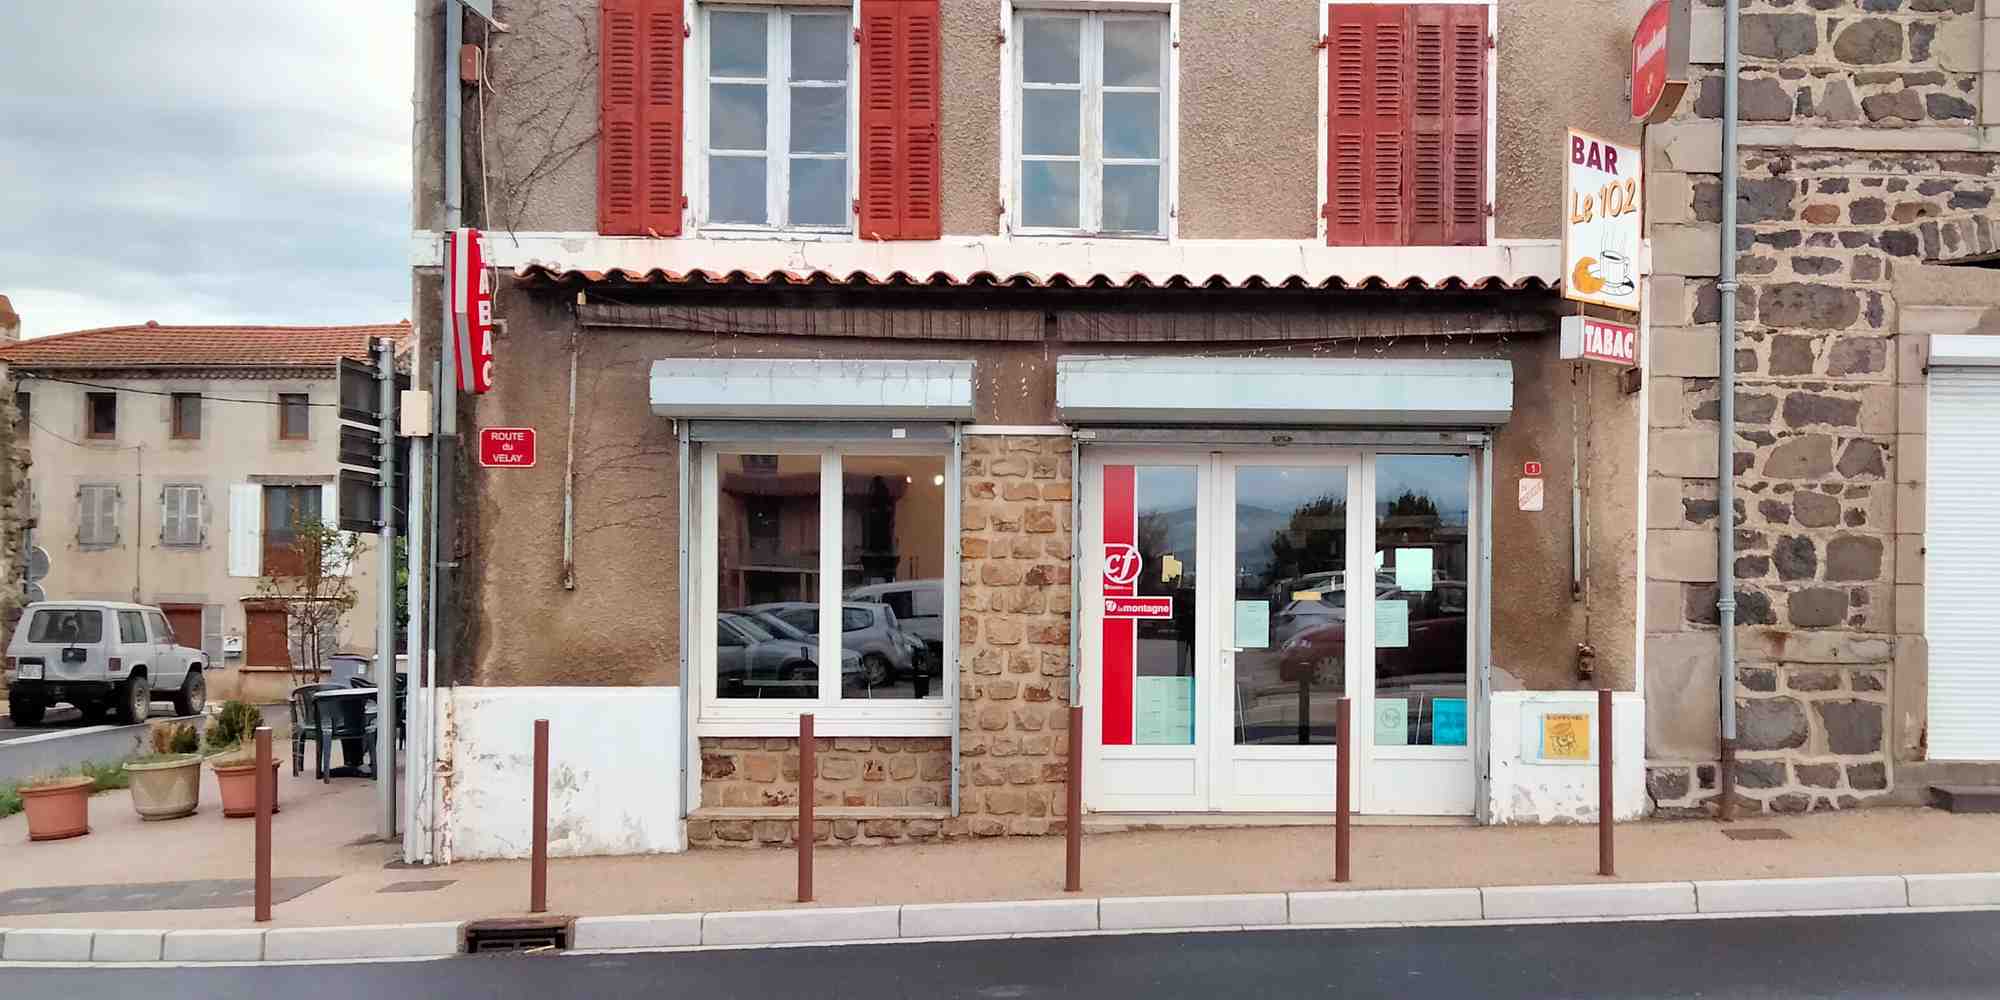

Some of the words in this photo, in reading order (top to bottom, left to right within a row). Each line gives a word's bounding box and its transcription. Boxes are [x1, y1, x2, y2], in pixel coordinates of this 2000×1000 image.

[1572, 135, 1618, 175] BAR
[1569, 190, 1594, 225] Le
[1600, 178, 1636, 218] 102
[476, 231, 494, 387] TABAC
[1585, 325, 1634, 359] TABAC
[491, 432, 524, 441] ROUTE
[492, 453, 523, 463] VELAY
